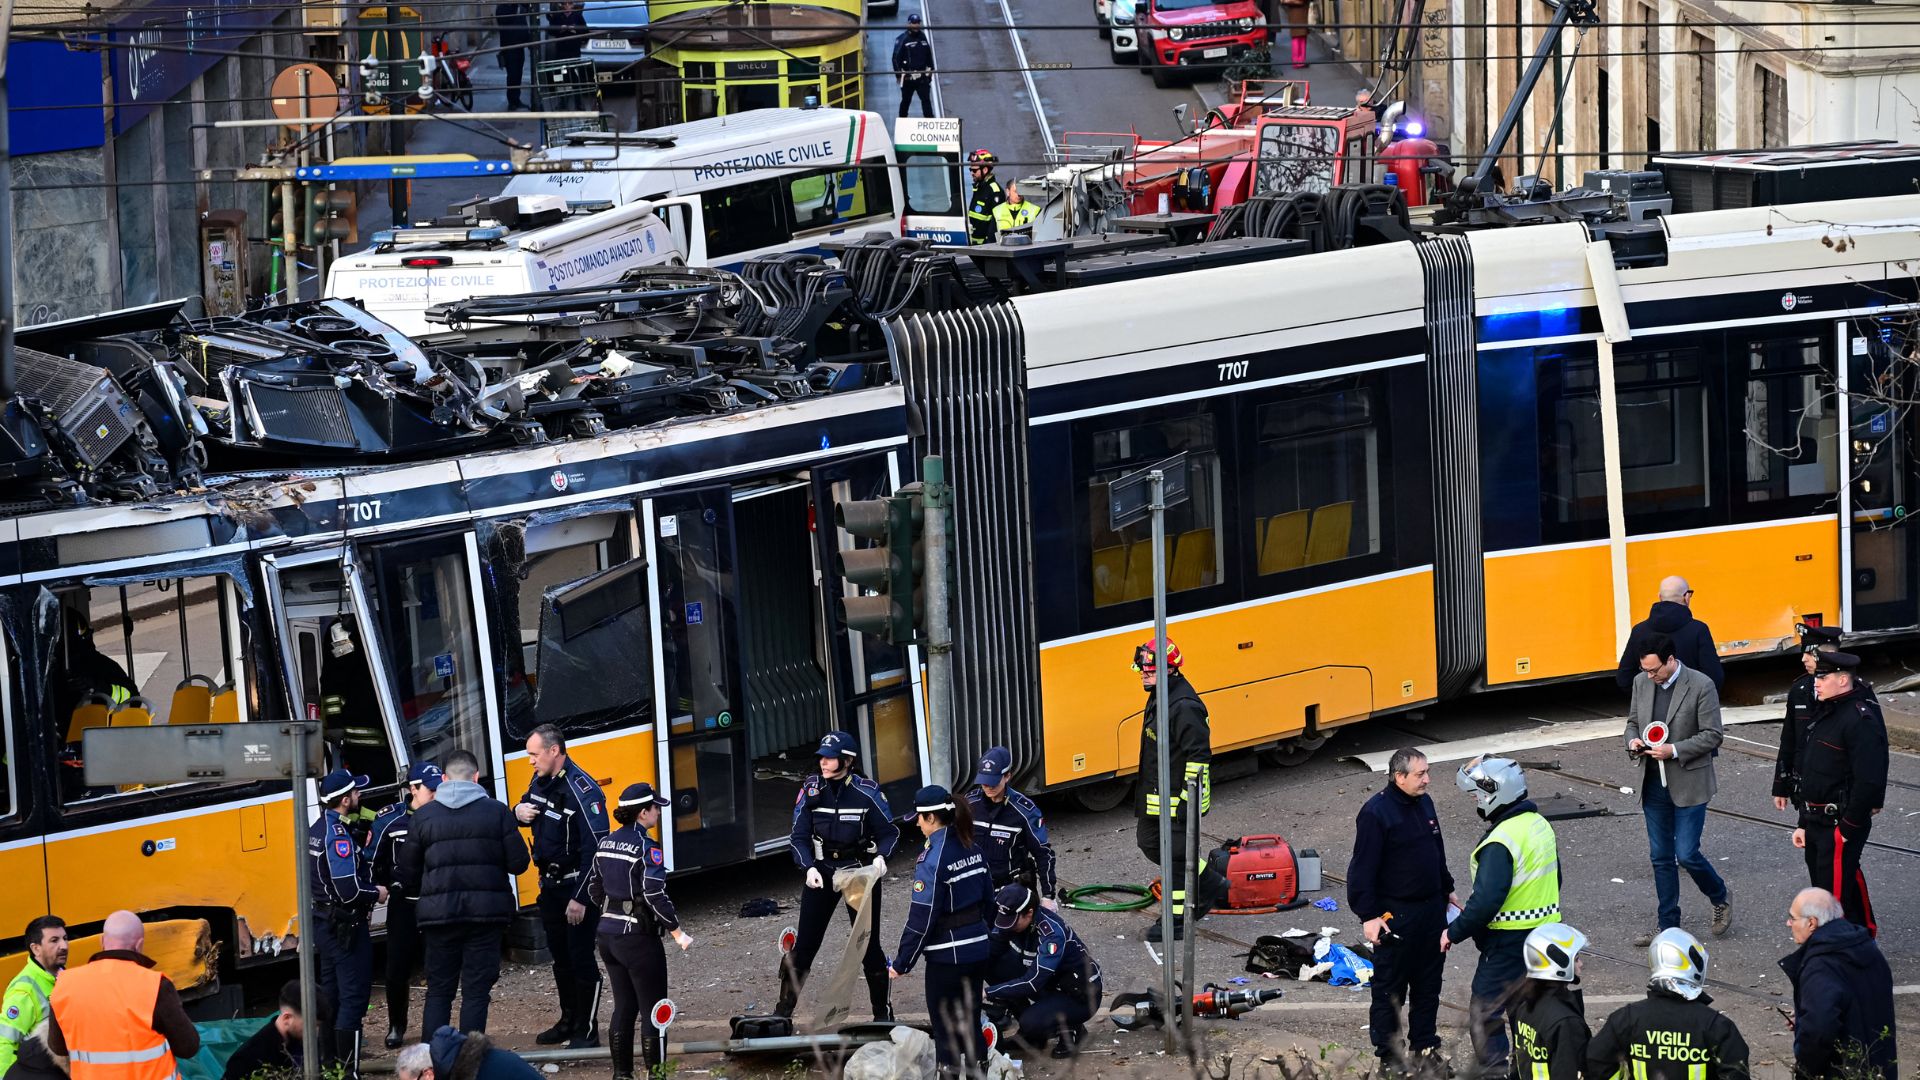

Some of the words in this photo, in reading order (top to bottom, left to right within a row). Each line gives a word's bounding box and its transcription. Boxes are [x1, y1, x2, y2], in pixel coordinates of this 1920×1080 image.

[910, 133, 950, 142] COLONNA
[694, 150, 786, 181] PROTEZIONE
[788, 141, 834, 162] CIVILE
[546, 175, 584, 184] MILANO
[916, 232, 952, 243] MILANO
[548, 261, 574, 283] POSTO
[574, 249, 610, 274] COMANDO
[609, 237, 643, 262] AVANZATO
[359, 277, 447, 289] PROTEZIONE
[451, 275, 494, 286] CIVILE
[1217, 360, 1249, 381] 7707
[616, 841, 639, 855] LOCALE
[1646, 1030, 1690, 1047] VIGILI
